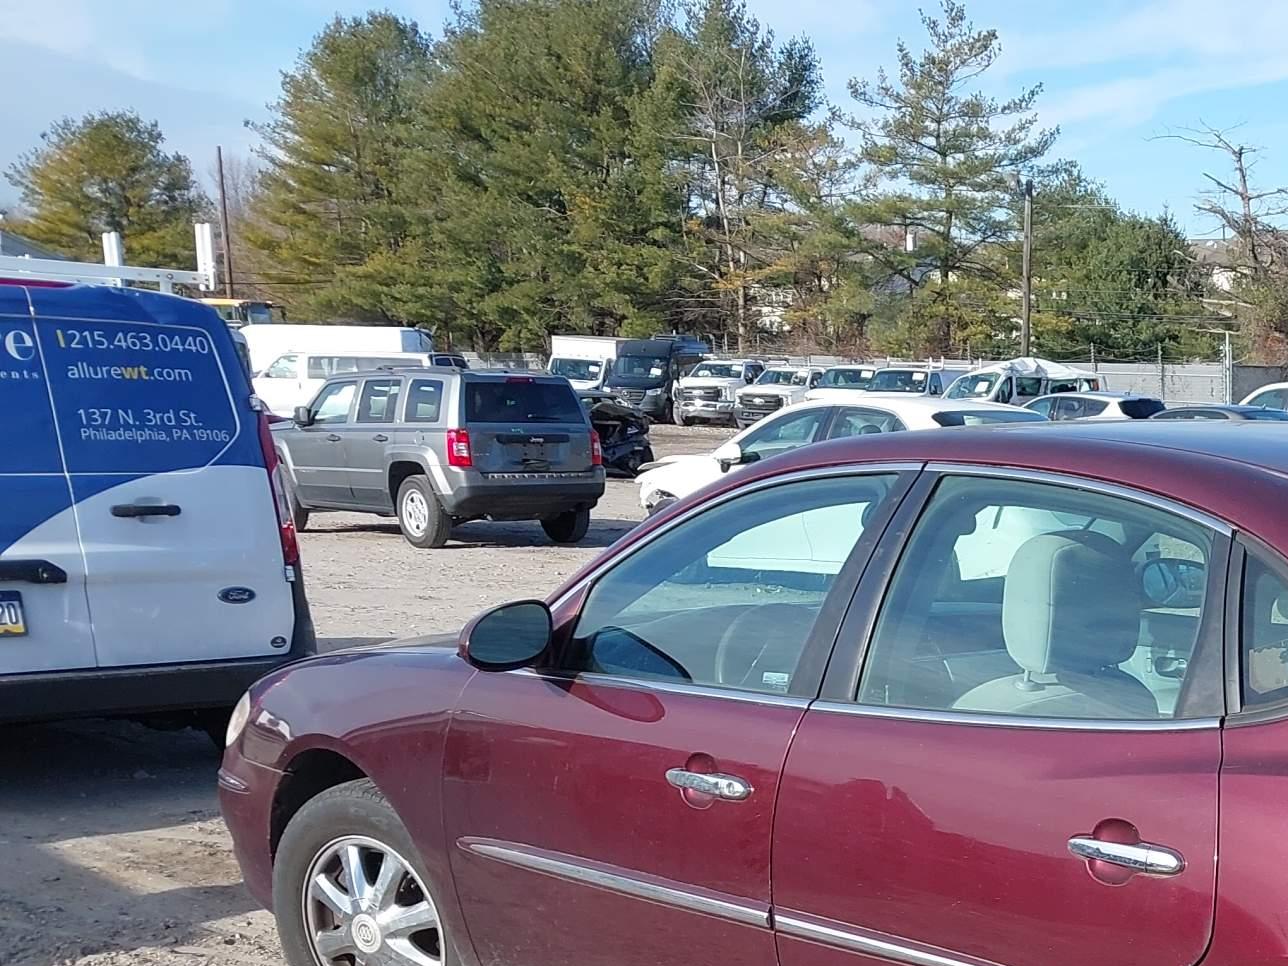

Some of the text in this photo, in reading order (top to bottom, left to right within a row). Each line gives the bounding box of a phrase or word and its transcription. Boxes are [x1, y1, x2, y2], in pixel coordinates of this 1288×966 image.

[67, 361, 192, 382] allurewt.com
[77, 408, 203, 427] 137 N. 3rd St.
[80, 428, 230, 444] Philadelphia, PA 19106
